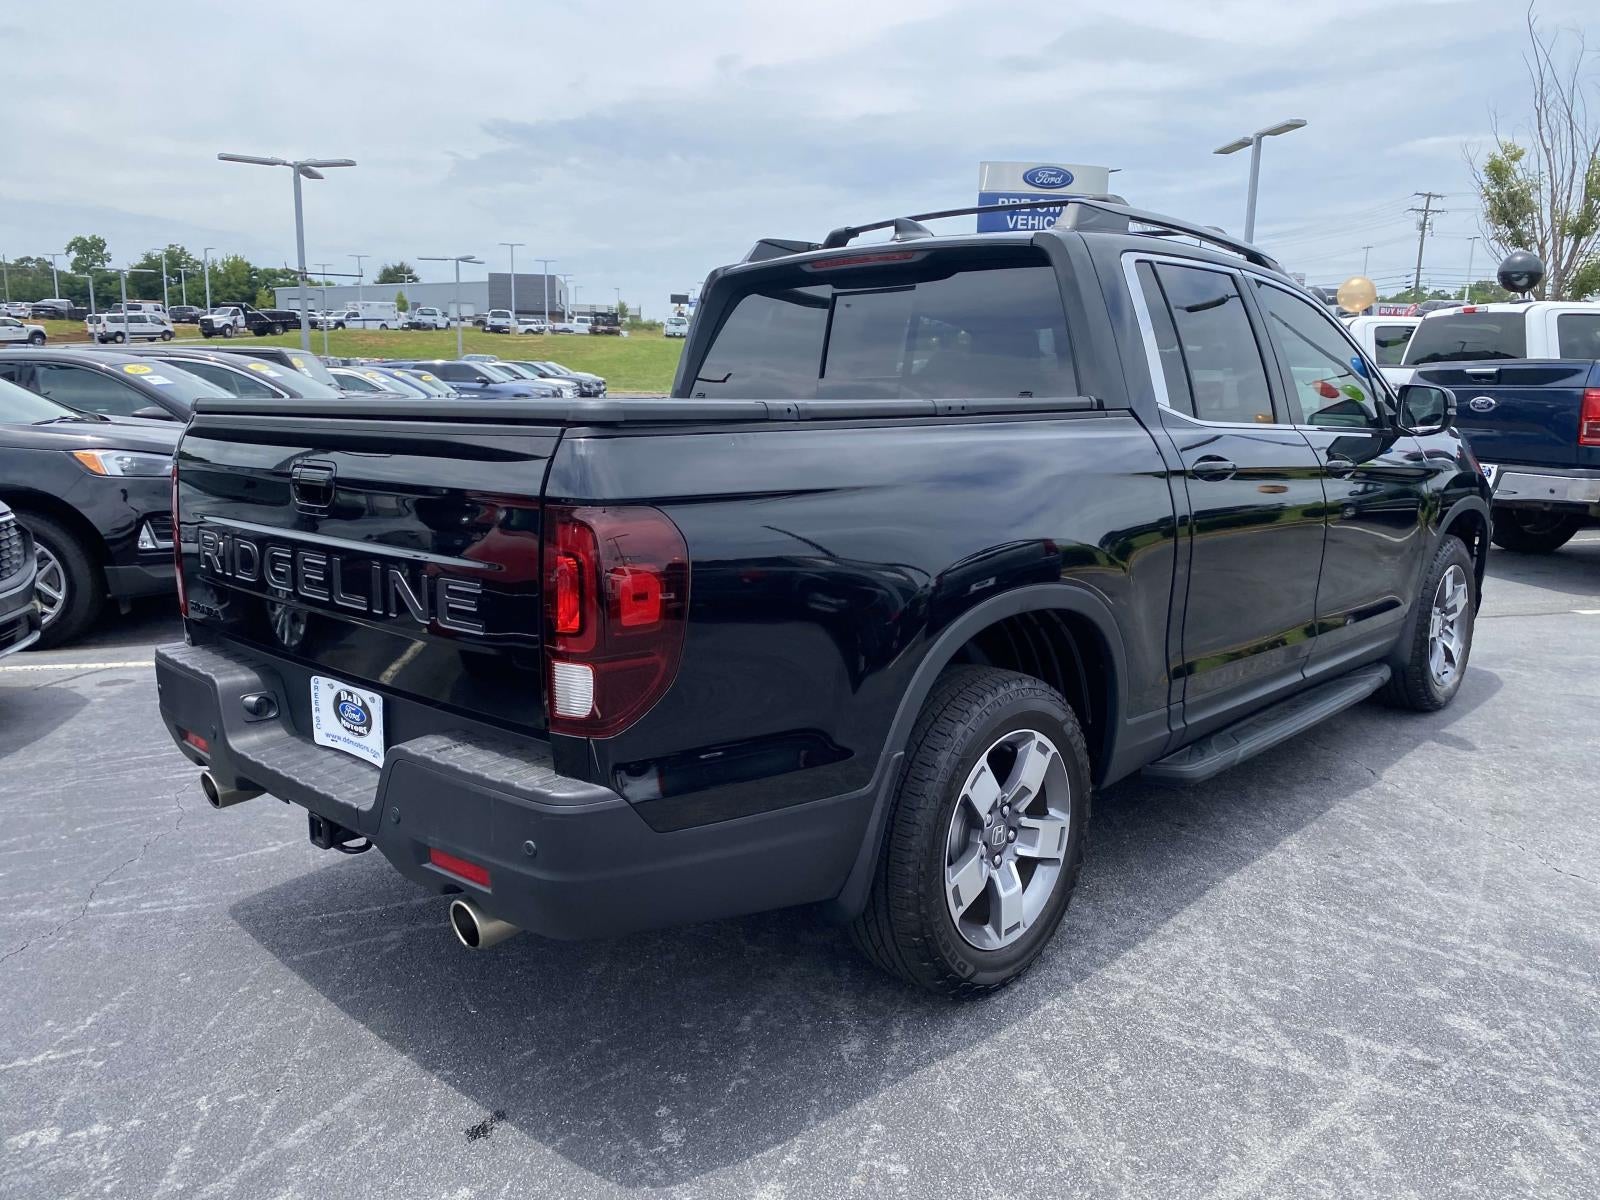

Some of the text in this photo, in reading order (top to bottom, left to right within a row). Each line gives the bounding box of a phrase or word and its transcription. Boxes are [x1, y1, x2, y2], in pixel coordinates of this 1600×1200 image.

[1035, 170, 1063, 184] Ford
[1006, 215, 1059, 230] VEHIC
[1380, 307, 1397, 315] BUY
[198, 529, 485, 636] RIDGELINE
[340, 690, 362, 707] D&D
[344, 704, 361, 721] Ford
